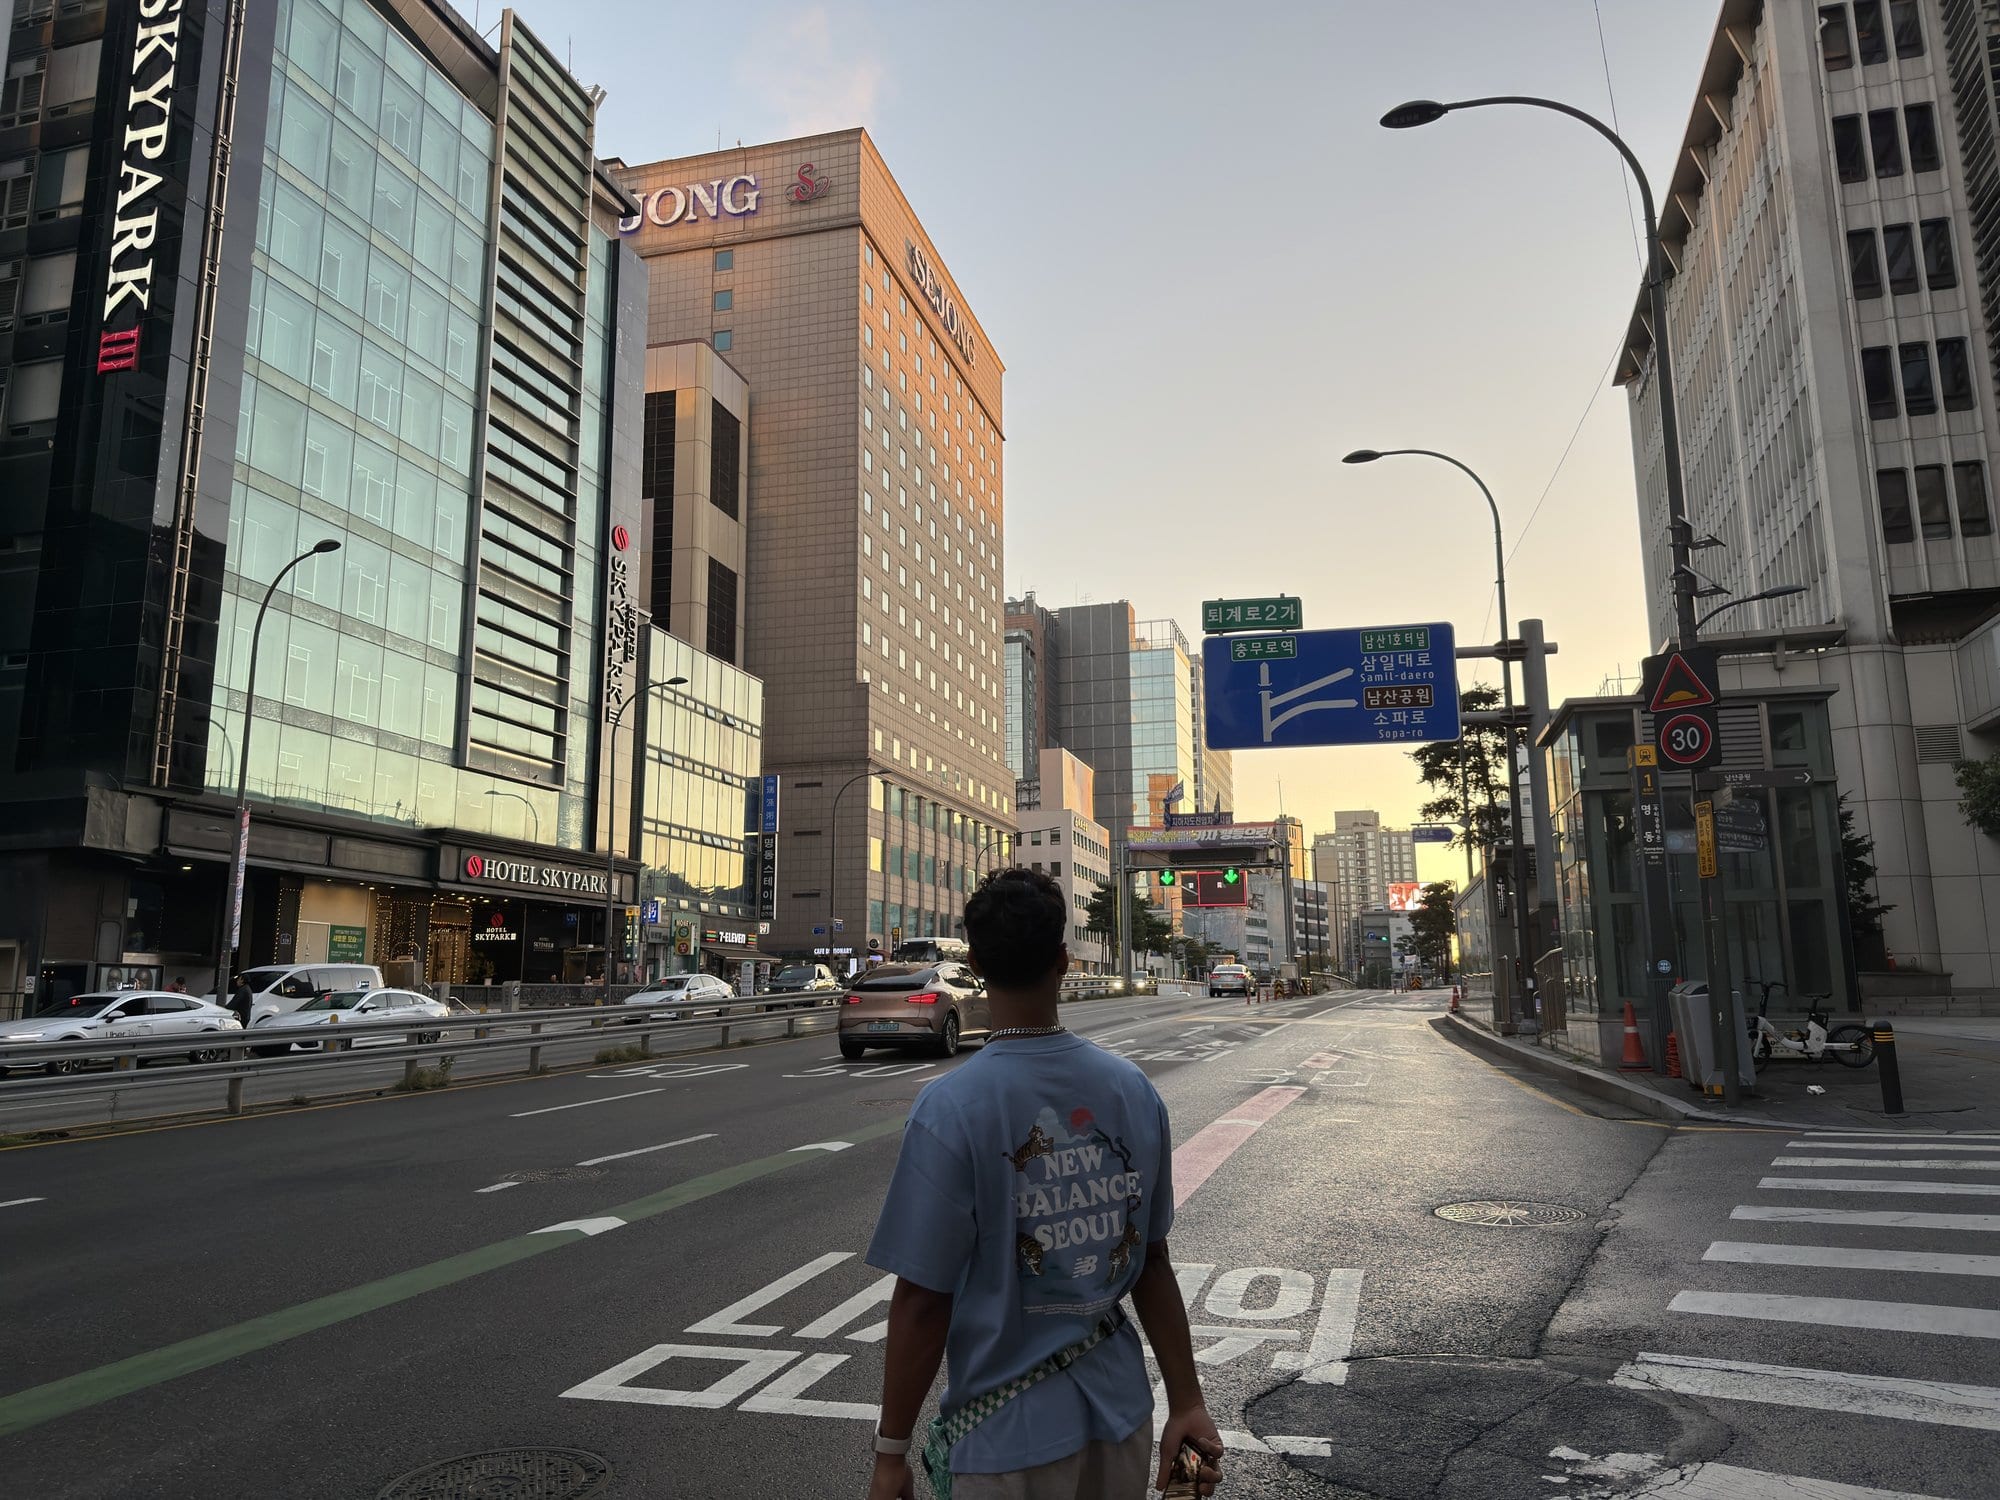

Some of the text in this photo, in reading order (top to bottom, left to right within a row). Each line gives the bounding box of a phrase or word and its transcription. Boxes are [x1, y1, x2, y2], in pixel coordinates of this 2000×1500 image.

[913, 244, 976, 370] SEJONG
[1207, 603, 1296, 623] 퇴계로2가
[609, 556, 627, 705] SKYPARK
[1365, 631, 1425, 649] 남산1호터널
[1234, 639, 1295, 658] 충무로역
[1361, 652, 1433, 672] 삼일대로
[1360, 671, 1435, 682] Samil-daero
[1367, 687, 1430, 706] 남산공원
[1373, 710, 1427, 725] 소파로
[1378, 728, 1423, 739] Sopa-ro
[1672, 727, 1700, 751] 30
[1643, 773, 1653, 787] 1
[1641, 804, 1654, 843] 명동
[763, 838, 774, 860] 명동
[483, 859, 540, 886] HOTEL
[541, 867, 608, 895] SKYPARK
[763, 864, 774, 900] 스테이
[475, 933, 511, 941] SKYPARK
[719, 931, 746, 944] 7-ELEVEN
[586, 1063, 750, 1078] 50
[782, 1063, 937, 1078] 50
[1043, 1144, 1105, 1181] NEW
[1013, 1171, 1143, 1218] BALANCE
[1034, 1210, 1125, 1251] SEOUL
